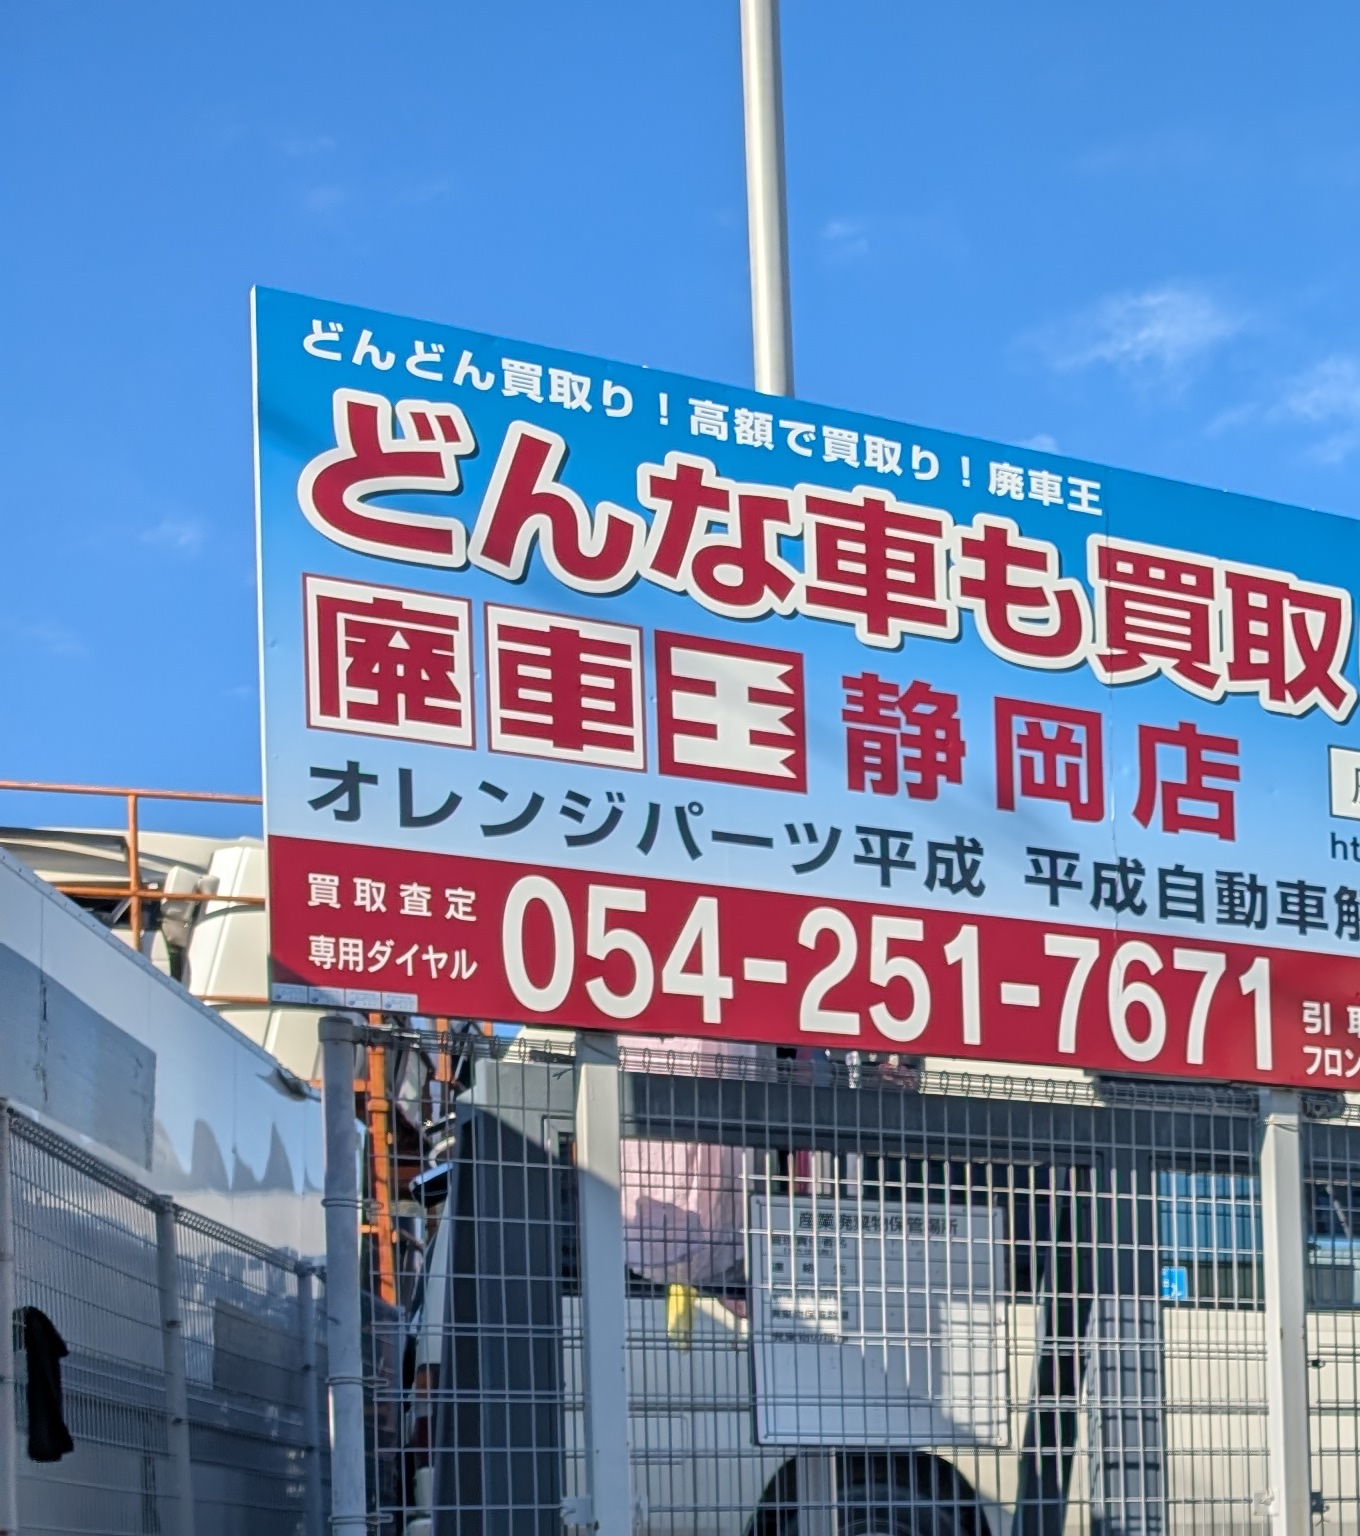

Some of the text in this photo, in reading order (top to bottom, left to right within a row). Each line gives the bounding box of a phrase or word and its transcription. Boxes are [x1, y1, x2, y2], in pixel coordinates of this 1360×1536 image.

[307, 760, 986, 897] オレンジパーツ平成
[307, 873, 478, 922] 買取査定
[307, 933, 478, 982] 専用ダイヤル
[502, 875, 1273, 1071] 054-251-7671
